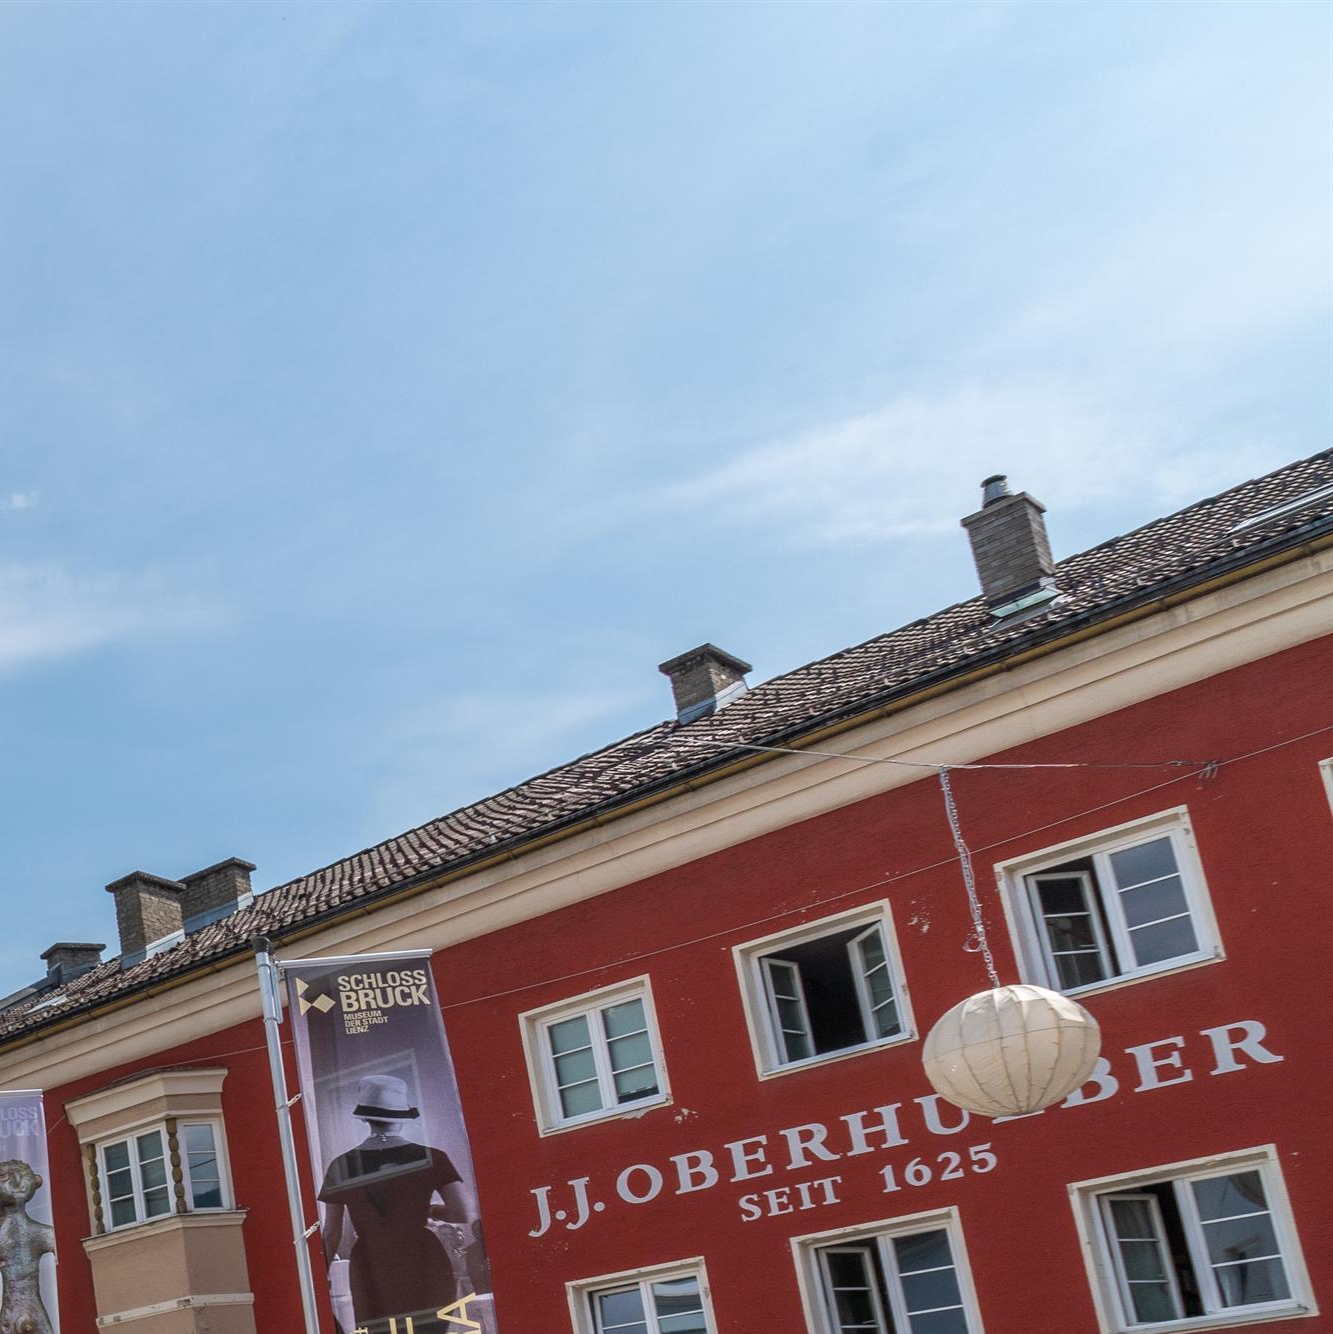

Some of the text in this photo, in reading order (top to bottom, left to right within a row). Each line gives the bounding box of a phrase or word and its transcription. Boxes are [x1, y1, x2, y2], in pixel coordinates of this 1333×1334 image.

[337, 969, 427, 991] SCHLOSS
[340, 984, 431, 1012] BRUCK
[343, 1010, 382, 1021] MUSEUM
[344, 1016, 389, 1028] DER STADT
[345, 1025, 370, 1035] LIENZ
[616, 1019, 1285, 1204] OBERHUBER
[738, 1142, 998, 1223] SEIT 1625
